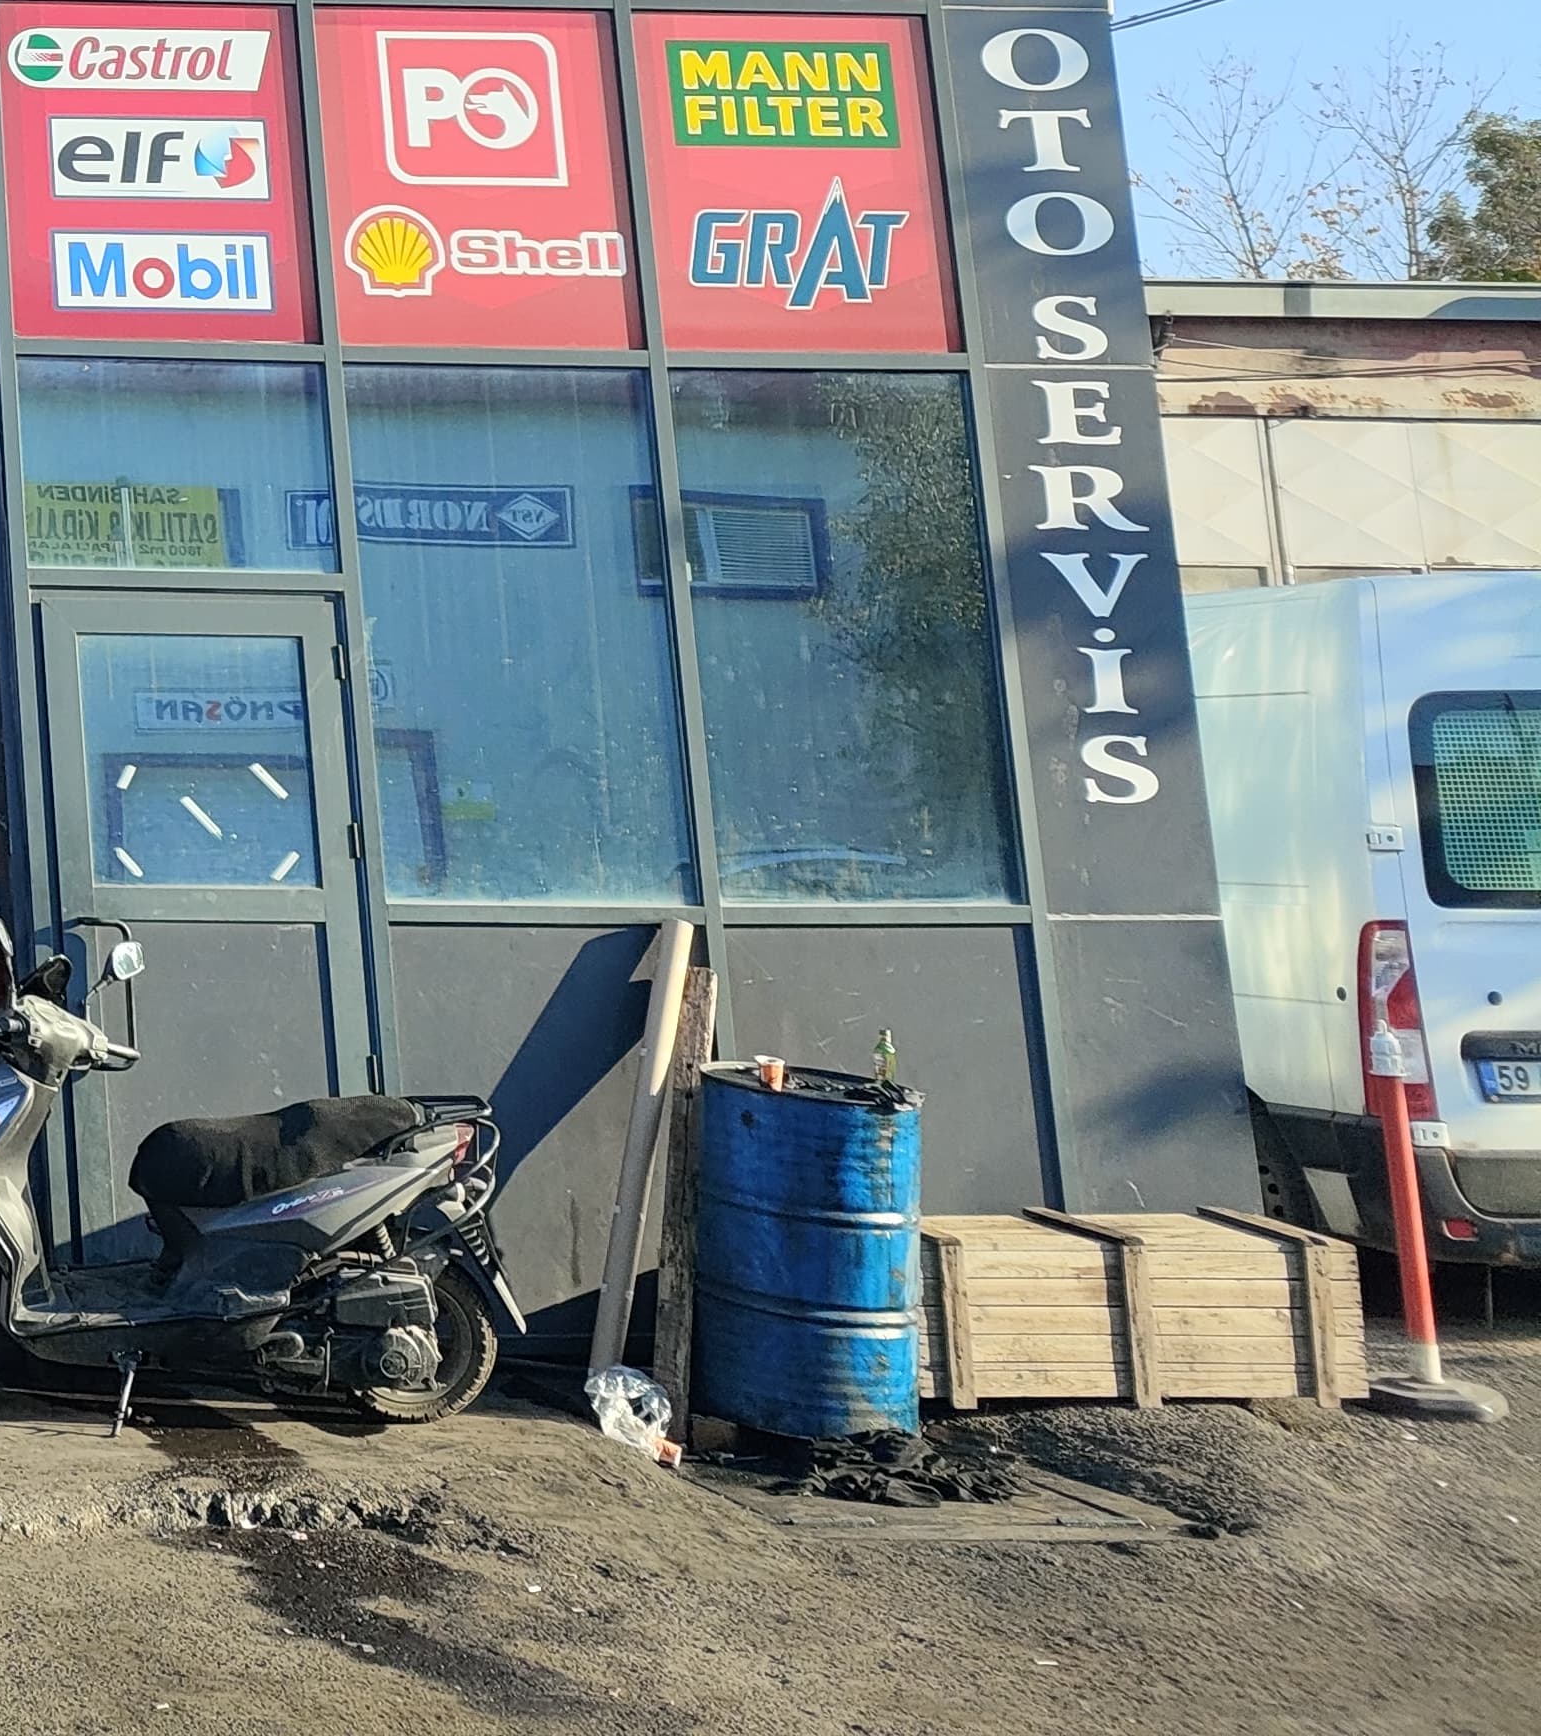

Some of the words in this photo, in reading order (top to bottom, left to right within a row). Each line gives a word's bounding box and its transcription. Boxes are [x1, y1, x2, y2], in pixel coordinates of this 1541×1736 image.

[69, 36, 234, 81] Castrol
[679, 50, 882, 92] MANN
[402, 67, 539, 149] PO
[684, 95, 889, 138] FILTER
[57, 130, 185, 183] elf
[979, 27, 1115, 257] OTO
[450, 229, 627, 277] Shell
[689, 176, 910, 310] GRAT
[67, 241, 258, 299] Mobil
[1027, 294, 1160, 805] SERVİS
[1498, 1065, 1530, 1092] 59
